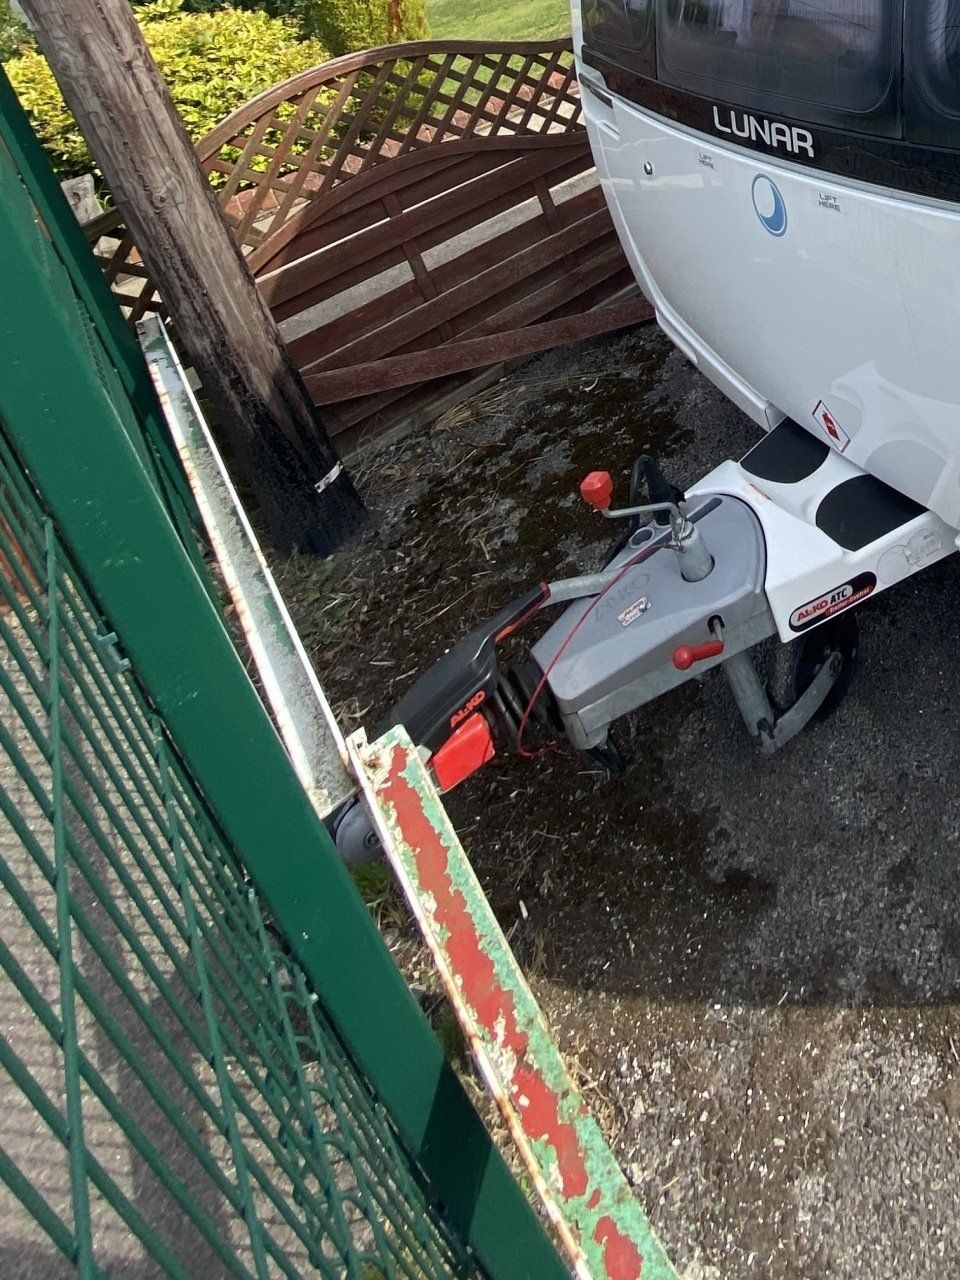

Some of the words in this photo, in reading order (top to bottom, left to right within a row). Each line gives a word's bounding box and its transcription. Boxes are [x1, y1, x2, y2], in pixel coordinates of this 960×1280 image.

[712, 106, 815, 158] LUNAR
[819, 192, 837, 203] LIFT
[818, 200, 841, 212] HERE
[830, 587, 848, 604] ATC
